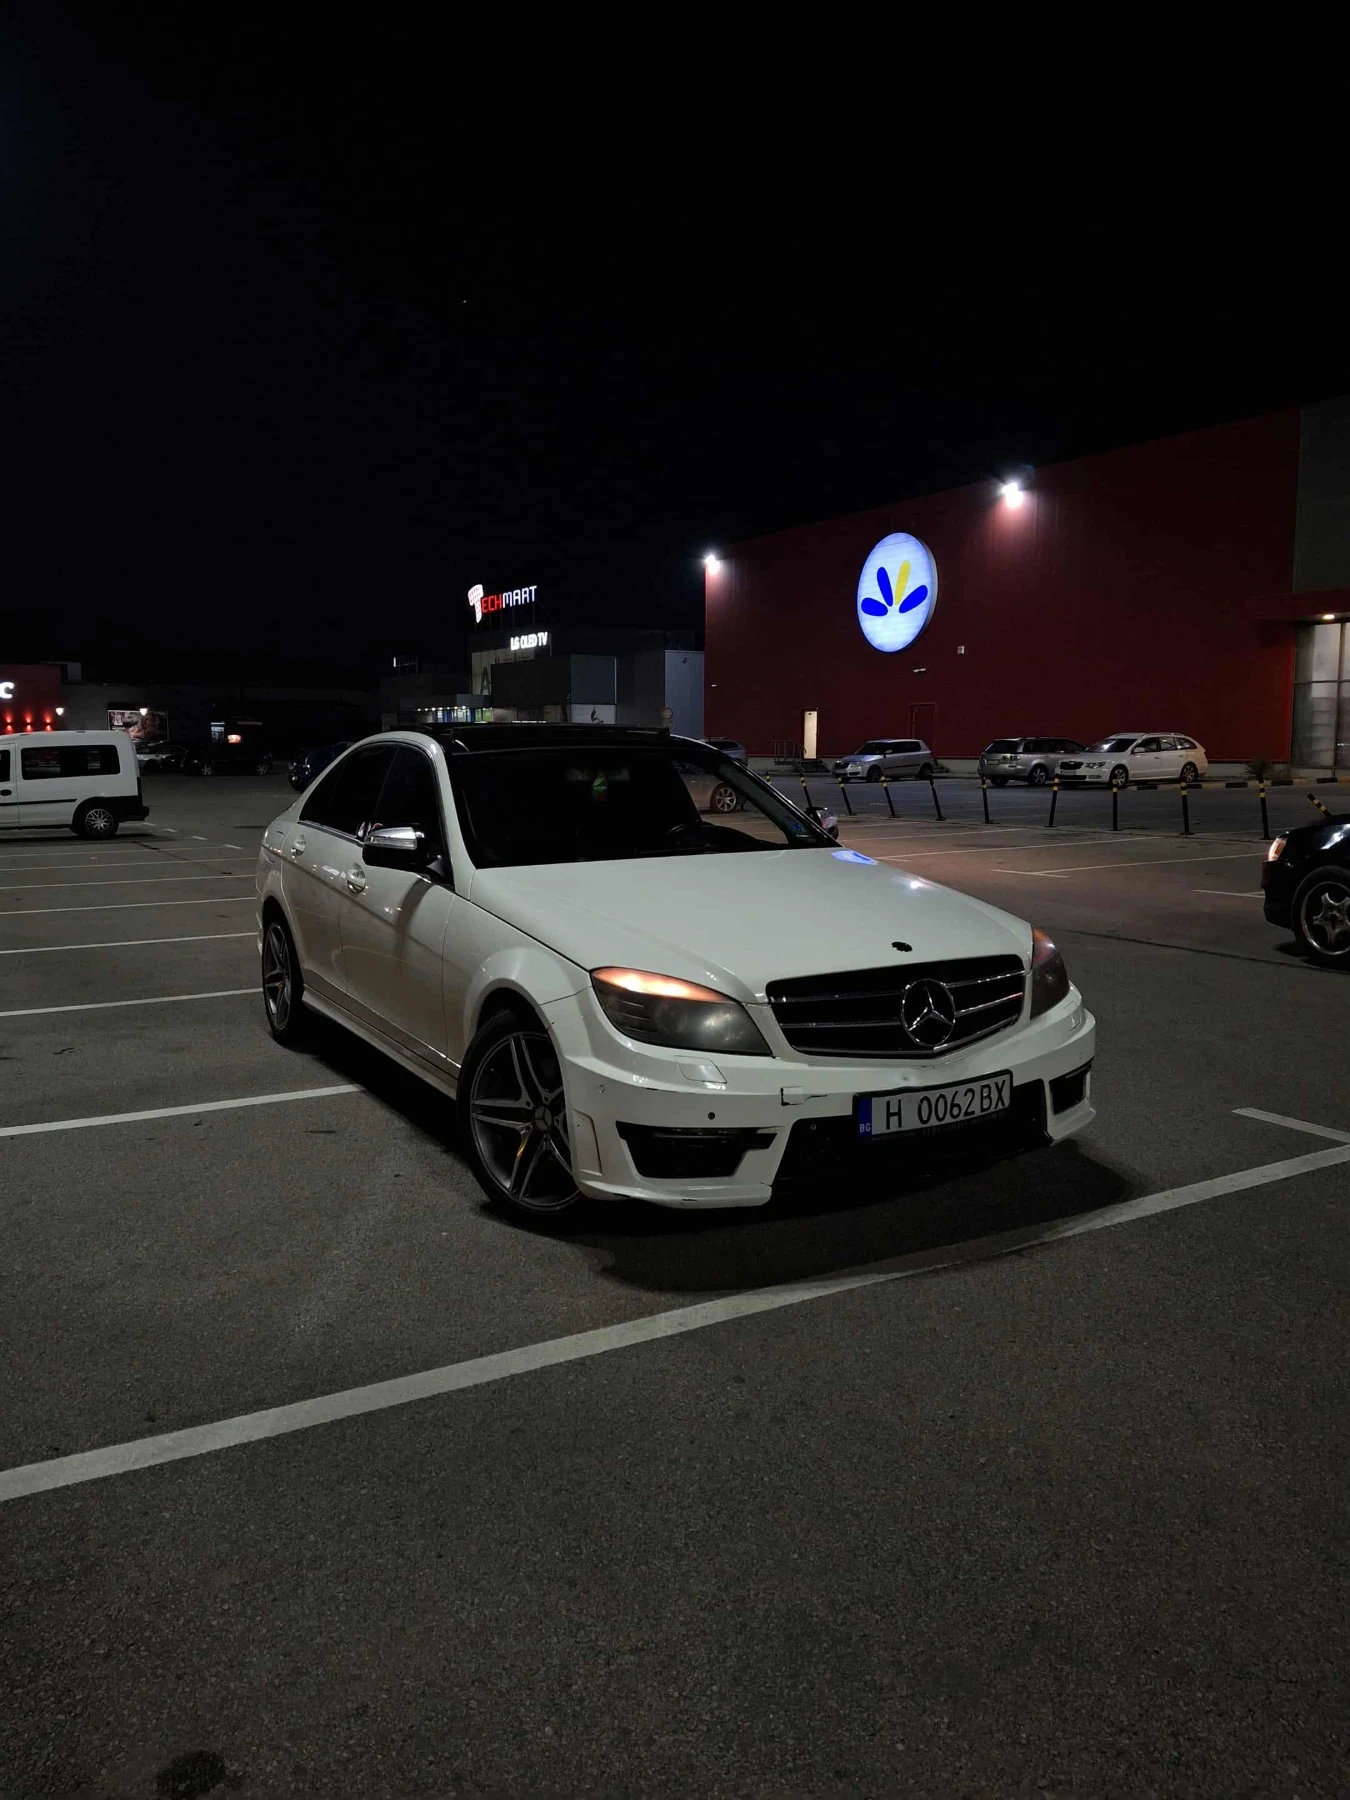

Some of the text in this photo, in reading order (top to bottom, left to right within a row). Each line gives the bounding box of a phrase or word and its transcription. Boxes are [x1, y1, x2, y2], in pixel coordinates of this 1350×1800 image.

[468, 584, 537, 623] TECHMART
[510, 631, 548, 651] LG OLED TV
[859, 1122, 871, 1133] BG
